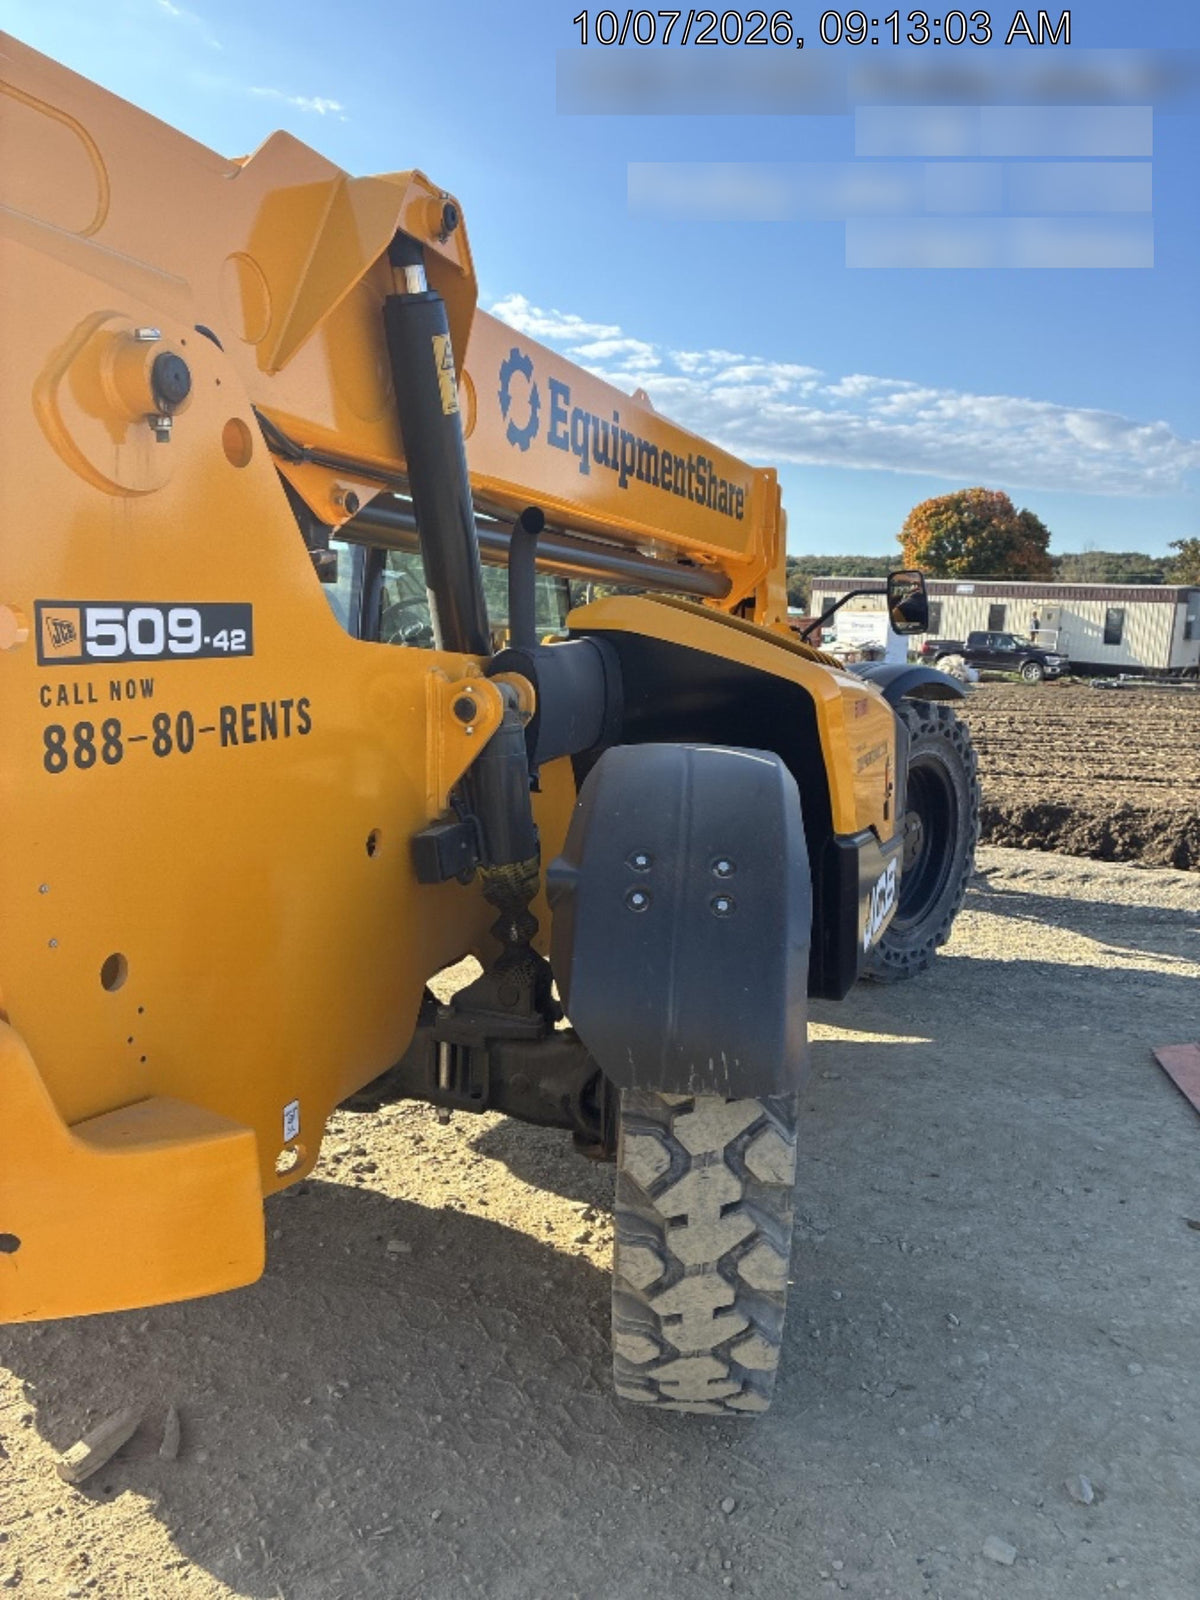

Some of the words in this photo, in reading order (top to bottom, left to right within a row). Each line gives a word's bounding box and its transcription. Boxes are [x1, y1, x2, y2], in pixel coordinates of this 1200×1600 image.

[547, 376, 744, 520] EquipmentShare
[47, 617, 76, 648] JCB
[40, 682, 98, 708] CALL
[109, 678, 155, 701] NOW
[43, 697, 312, 774] 888-80-RENTS
